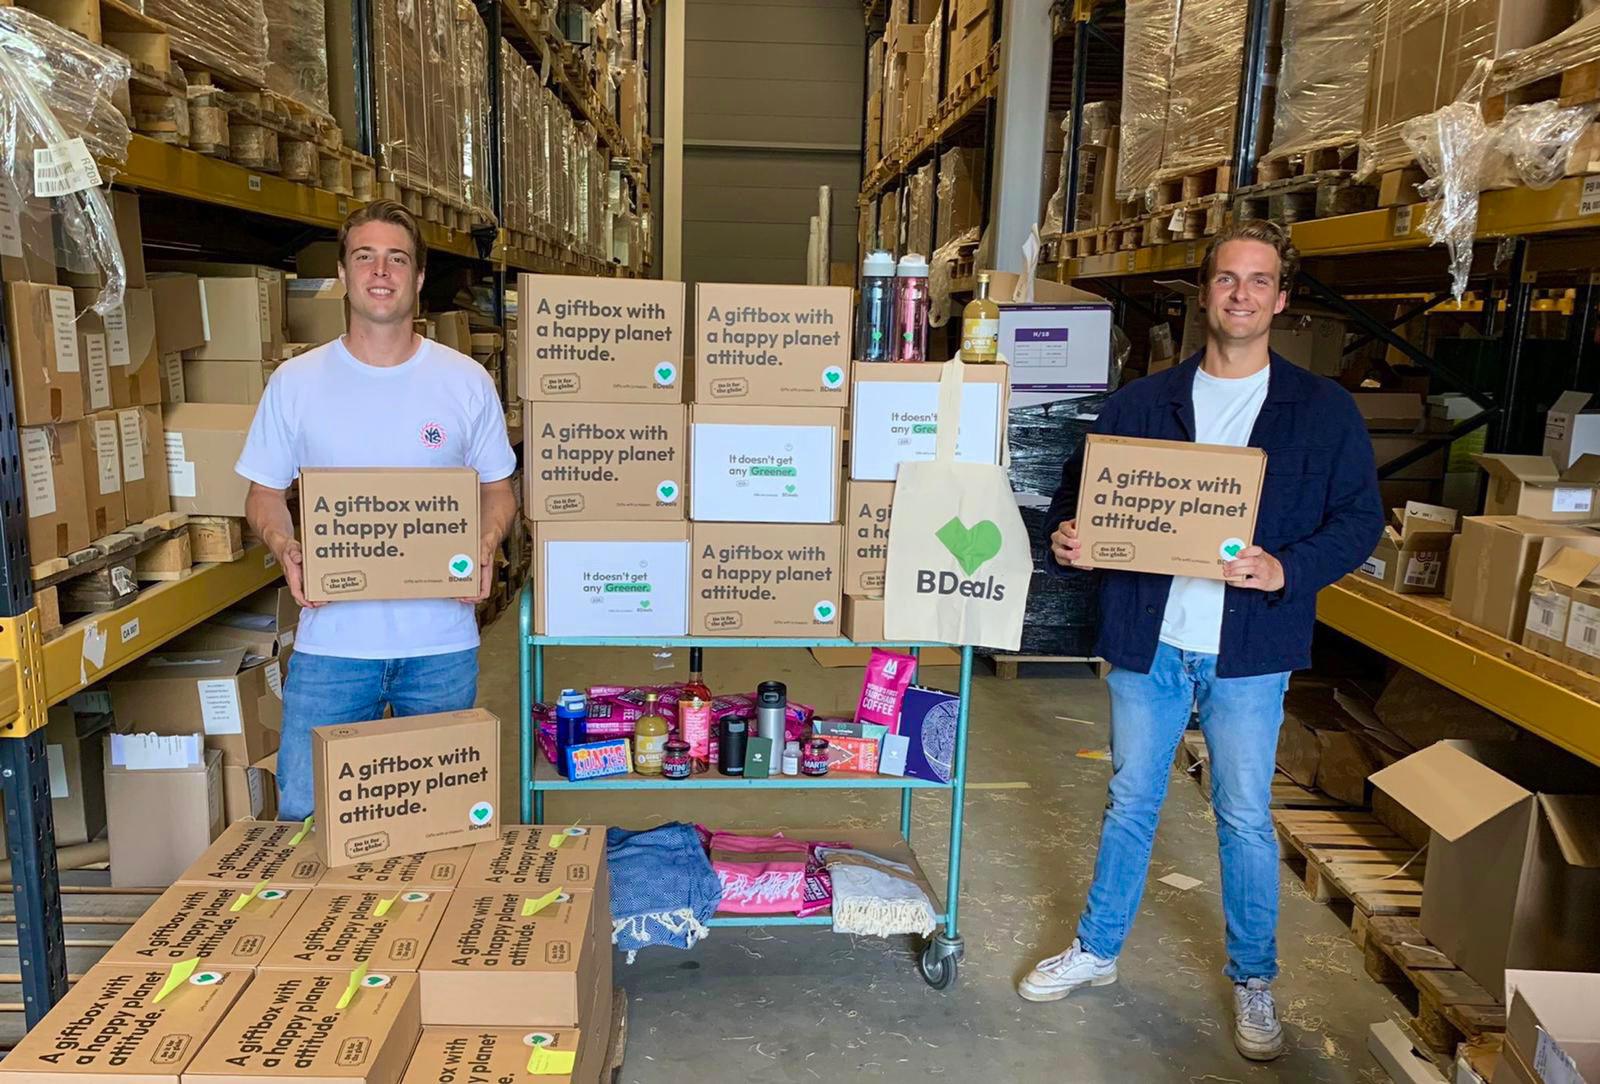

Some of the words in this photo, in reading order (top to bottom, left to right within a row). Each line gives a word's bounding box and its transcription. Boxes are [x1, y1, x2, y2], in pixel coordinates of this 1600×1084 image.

[537, 298, 551, 314] A
[555, 299, 622, 319] giftbox
[626, 303, 665, 319] with
[707, 306, 720, 321] A
[725, 306, 790, 326] giftbox
[794, 308, 833, 324] with
[536, 325, 547, 336] a
[553, 321, 610, 343] happy
[615, 324, 672, 343] planet
[707, 332, 717, 342] a
[723, 328, 778, 348] happy
[783, 329, 840, 348] planet
[536, 344, 614, 361] attitude.
[706, 349, 782, 365] attitude.
[892, 412, 899, 421] It
[901, 412, 937, 421] doesn't
[541, 423, 555, 438] A
[559, 423, 625, 442] giftbox
[629, 425, 667, 440] with
[890, 426, 909, 435] any
[541, 449, 552, 459] a
[558, 444, 614, 464] happy
[618, 445, 674, 464] planet
[729, 454, 736, 463] It
[738, 454, 774, 464] doesn't
[776, 456, 792, 466] get
[541, 466, 618, 481] attitude.
[728, 468, 747, 478] any
[751, 466, 795, 476] Greener.
[1097, 467, 1112, 483] A
[1116, 469, 1192, 490] giftbox
[1197, 477, 1241, 494] with
[314, 496, 330, 512] A
[334, 496, 410, 516] giftbox
[414, 495, 458, 511] with
[859, 504, 872, 518] A
[1094, 494, 1106, 504] a
[1112, 490, 1176, 515] happy
[1179, 497, 1247, 517] planet
[314, 524, 327, 535] a
[333, 519, 398, 539] happy
[403, 518, 467, 538] planet
[858, 526, 868, 538] a
[1091, 512, 1176, 533] attitude.
[315, 541, 404, 557] attitude.
[702, 545, 715, 559] A
[719, 545, 783, 563] giftbox
[787, 546, 825, 560] with
[584, 572, 590, 580] It
[592, 572, 630, 581] doesn't
[631, 572, 648, 582] get
[701, 569, 712, 578] a
[717, 564, 772, 583] happy
[776, 566, 832, 584] planet
[916, 570, 1005, 600] BDeals
[583, 586, 601, 594] any
[605, 584, 650, 592] Greener.
[701, 585, 775, 600] attitude.
[862, 697, 894, 716] COFFEE
[338, 763, 354, 779] A
[359, 755, 433, 780] giftbox
[438, 746, 479, 765] with
[339, 790, 351, 801] a
[357, 780, 421, 800] happy
[426, 767, 488, 794] planet
[339, 799, 426, 823] attitude.
[217, 843, 252, 870] giftbox
[243, 827, 266, 842] with
[235, 848, 274, 871] happy
[261, 825, 290, 846] planet
[521, 828, 542, 850] planet
[260, 847, 296, 879] attitude.
[489, 847, 513, 874] giftbox
[501, 831, 519, 846] with
[510, 851, 538, 875] happy
[534, 850, 558, 883] attitude.
[328, 895, 352, 914] with
[473, 896, 494, 916] with
[495, 893, 519, 921] planet
[148, 912, 190, 946] giftbox
[180, 892, 208, 910] with
[169, 918, 214, 948] happy
[201, 889, 235, 916] planet
[324, 921, 364, 952] happy
[348, 892, 378, 919] planet
[196, 916, 239, 957] attitude.
[303, 916, 338, 950] giftbox
[352, 920, 388, 962] attitude.
[456, 918, 486, 954] giftbox
[480, 924, 513, 956] happy
[508, 922, 535, 966] attitude.
[293, 952, 314, 960] A
[450, 957, 471, 965] A
[122, 971, 164, 1008] planet
[296, 976, 332, 1012] planet
[38, 1052, 65, 1063] A
[55, 1002, 109, 1049] giftbox
[98, 975, 133, 1000] with
[226, 1056, 250, 1066] A
[238, 1007, 283, 1052] giftbox
[272, 980, 302, 1004] with
[78, 1010, 135, 1052] happy
[108, 1009, 165, 1065] attitude.
[262, 1014, 312, 1054] happy
[294, 1012, 340, 1068] attitude.
[76, 1055, 95, 1064] a
[262, 1058, 280, 1067] a
[446, 1038, 468, 1066] with
[472, 1033, 498, 1074] planet
